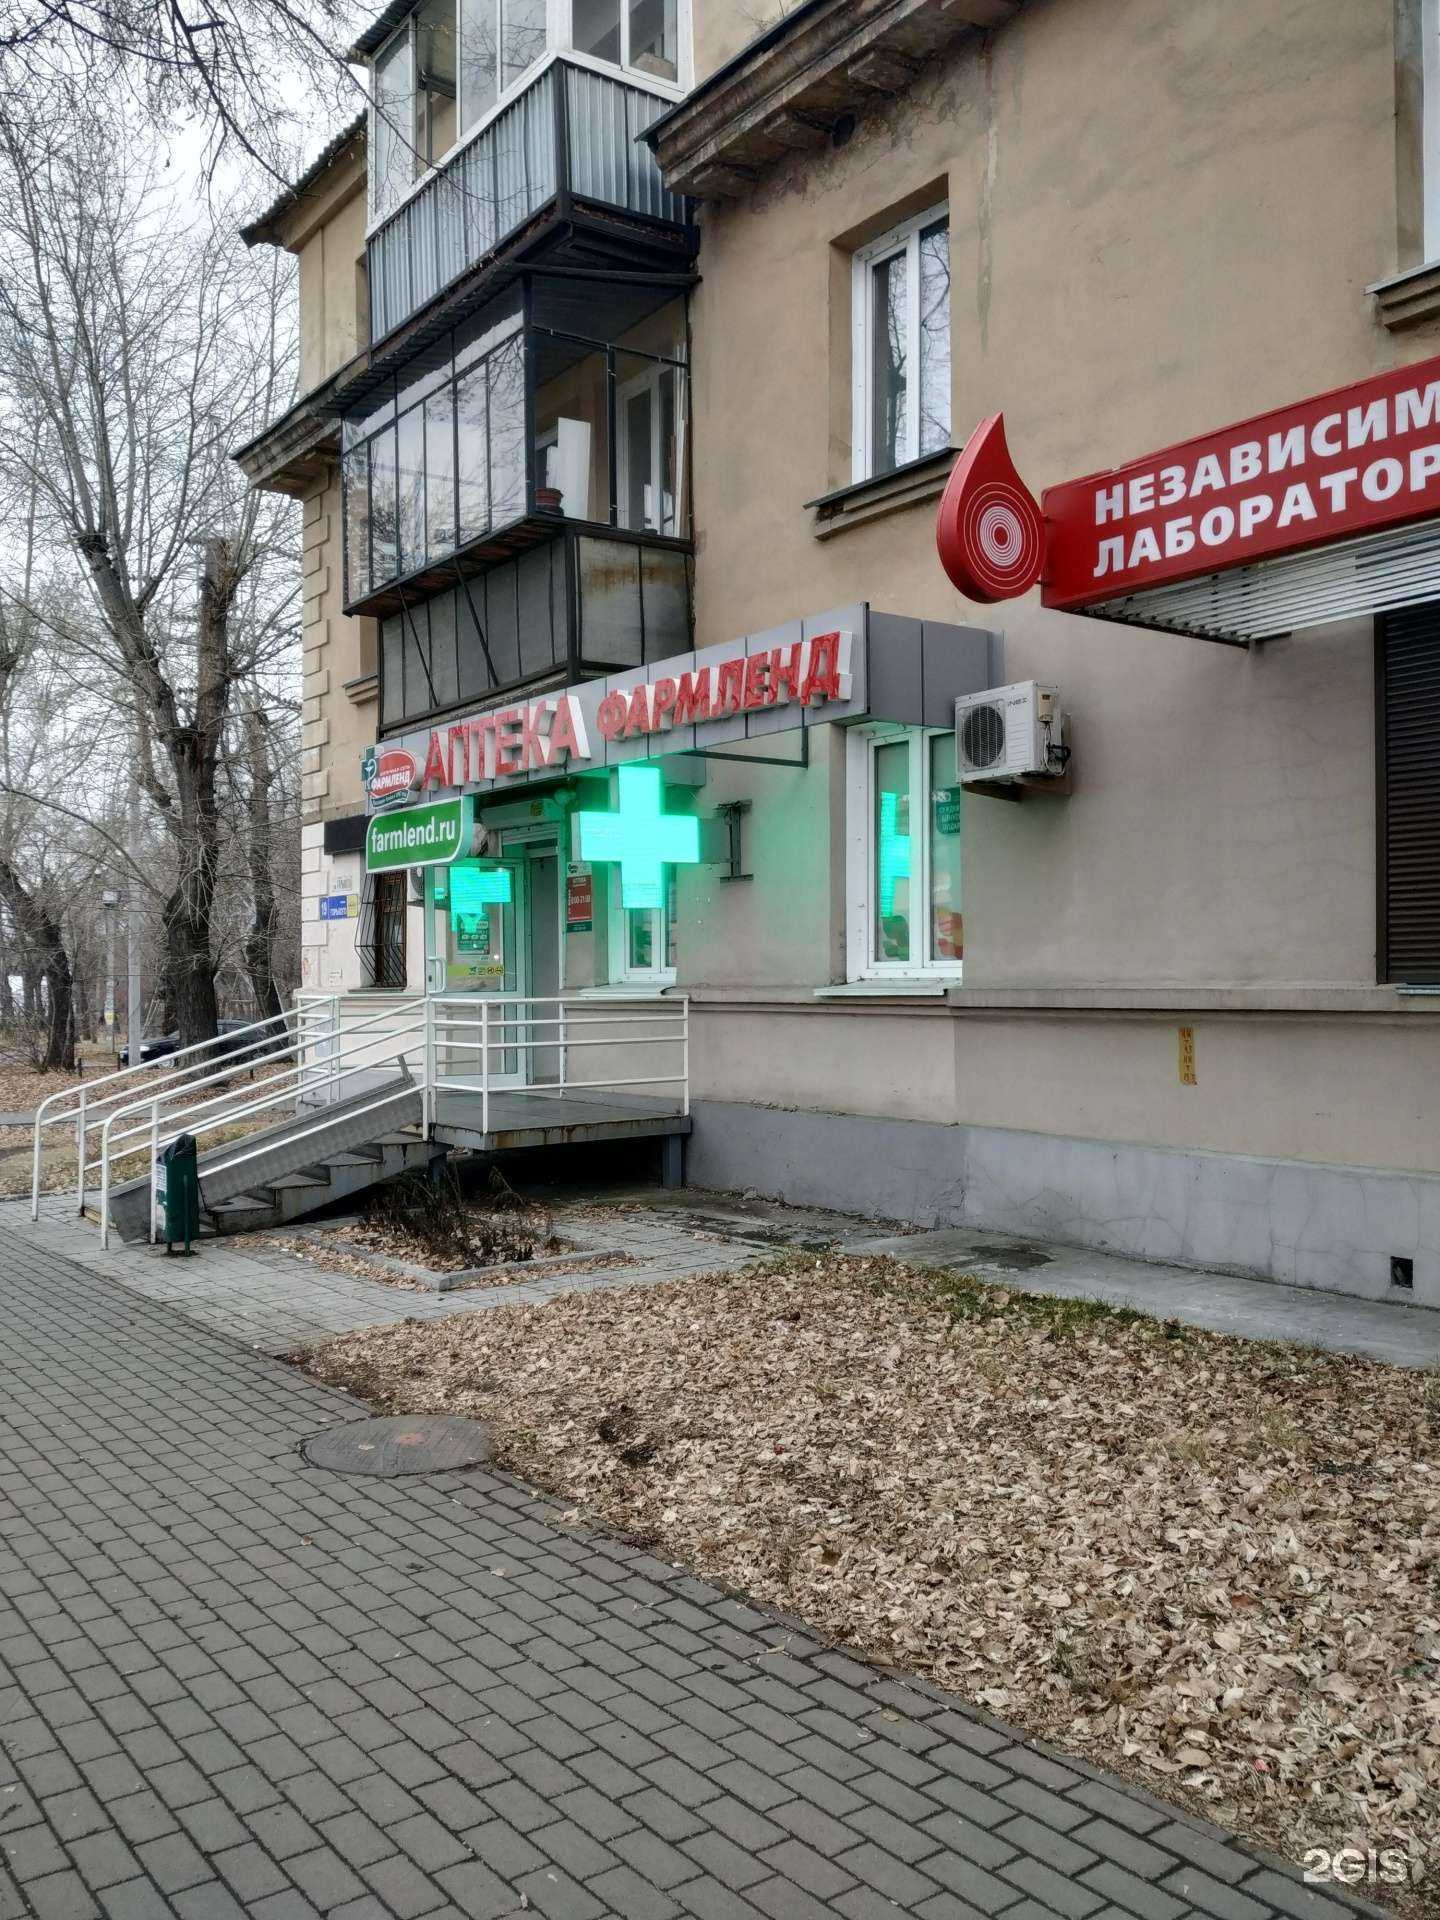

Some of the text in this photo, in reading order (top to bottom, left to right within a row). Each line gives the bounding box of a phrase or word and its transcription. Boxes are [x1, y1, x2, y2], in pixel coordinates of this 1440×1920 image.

[421, 631, 852, 791] АПТЕКА ФАРМЛЕНД
[371, 770, 410, 790] ФАРМЛЕНД
[371, 815, 455, 853] farmlend.ru
